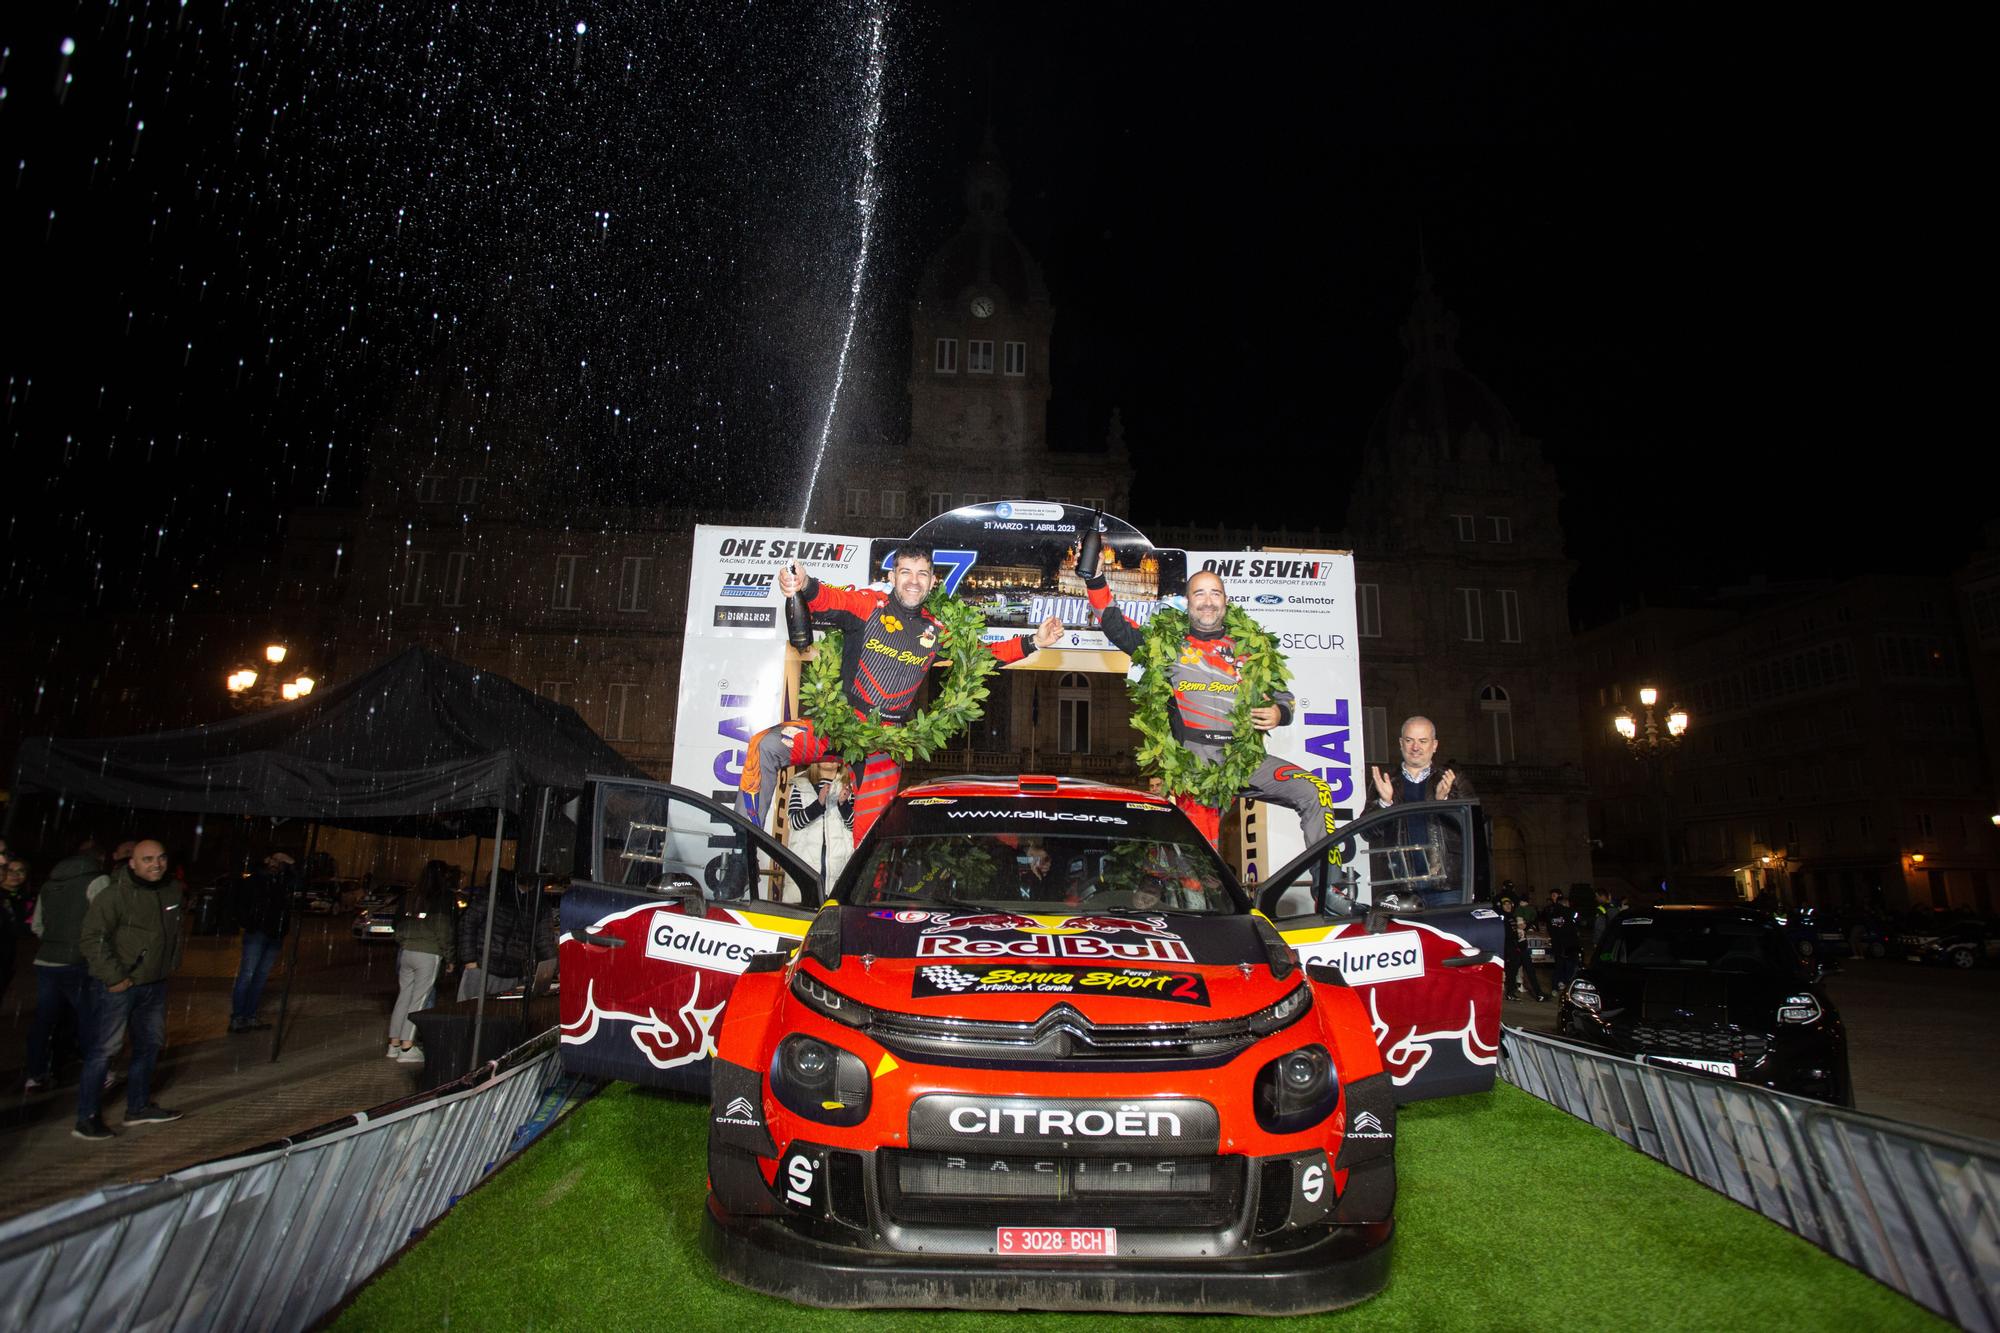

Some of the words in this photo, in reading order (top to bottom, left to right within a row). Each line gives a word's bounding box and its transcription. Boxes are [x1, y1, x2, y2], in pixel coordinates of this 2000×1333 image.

[983, 521, 992, 530] 31
[993, 522, 1023, 531] MARZO
[1030, 523, 1034, 531] 1
[1035, 523, 1056, 532] ABRIL
[1057, 524, 1076, 532] 2023
[719, 538, 766, 557] ONE
[773, 560, 822, 568] MOTSPORT
[821, 562, 849, 570] EVENTS
[1201, 559, 1246, 578] ONE
[1288, 595, 1335, 605] Galmotor
[1029, 596, 1090, 626] RALLYE
[1282, 633, 1345, 650] SECUR
[865, 638, 899, 657] Senra
[897, 650, 928, 667] Sport
[1178, 680, 1206, 692] Senra
[1207, 681, 1238, 694] Sport
[947, 810, 1128, 825] www.rallycar.es
[917, 934, 1056, 957] Red
[1059, 935, 1195, 963] Bull
[979, 969, 1074, 985] Senra
[1079, 972, 1172, 991] Sport
[1171, 974, 1200, 1000] 2
[1037, 983, 1074, 992] Coruña
[1002, 1232, 1013, 1249] S
[1021, 1231, 1063, 1250] 3028
[1070, 1231, 1102, 1250] BCH
